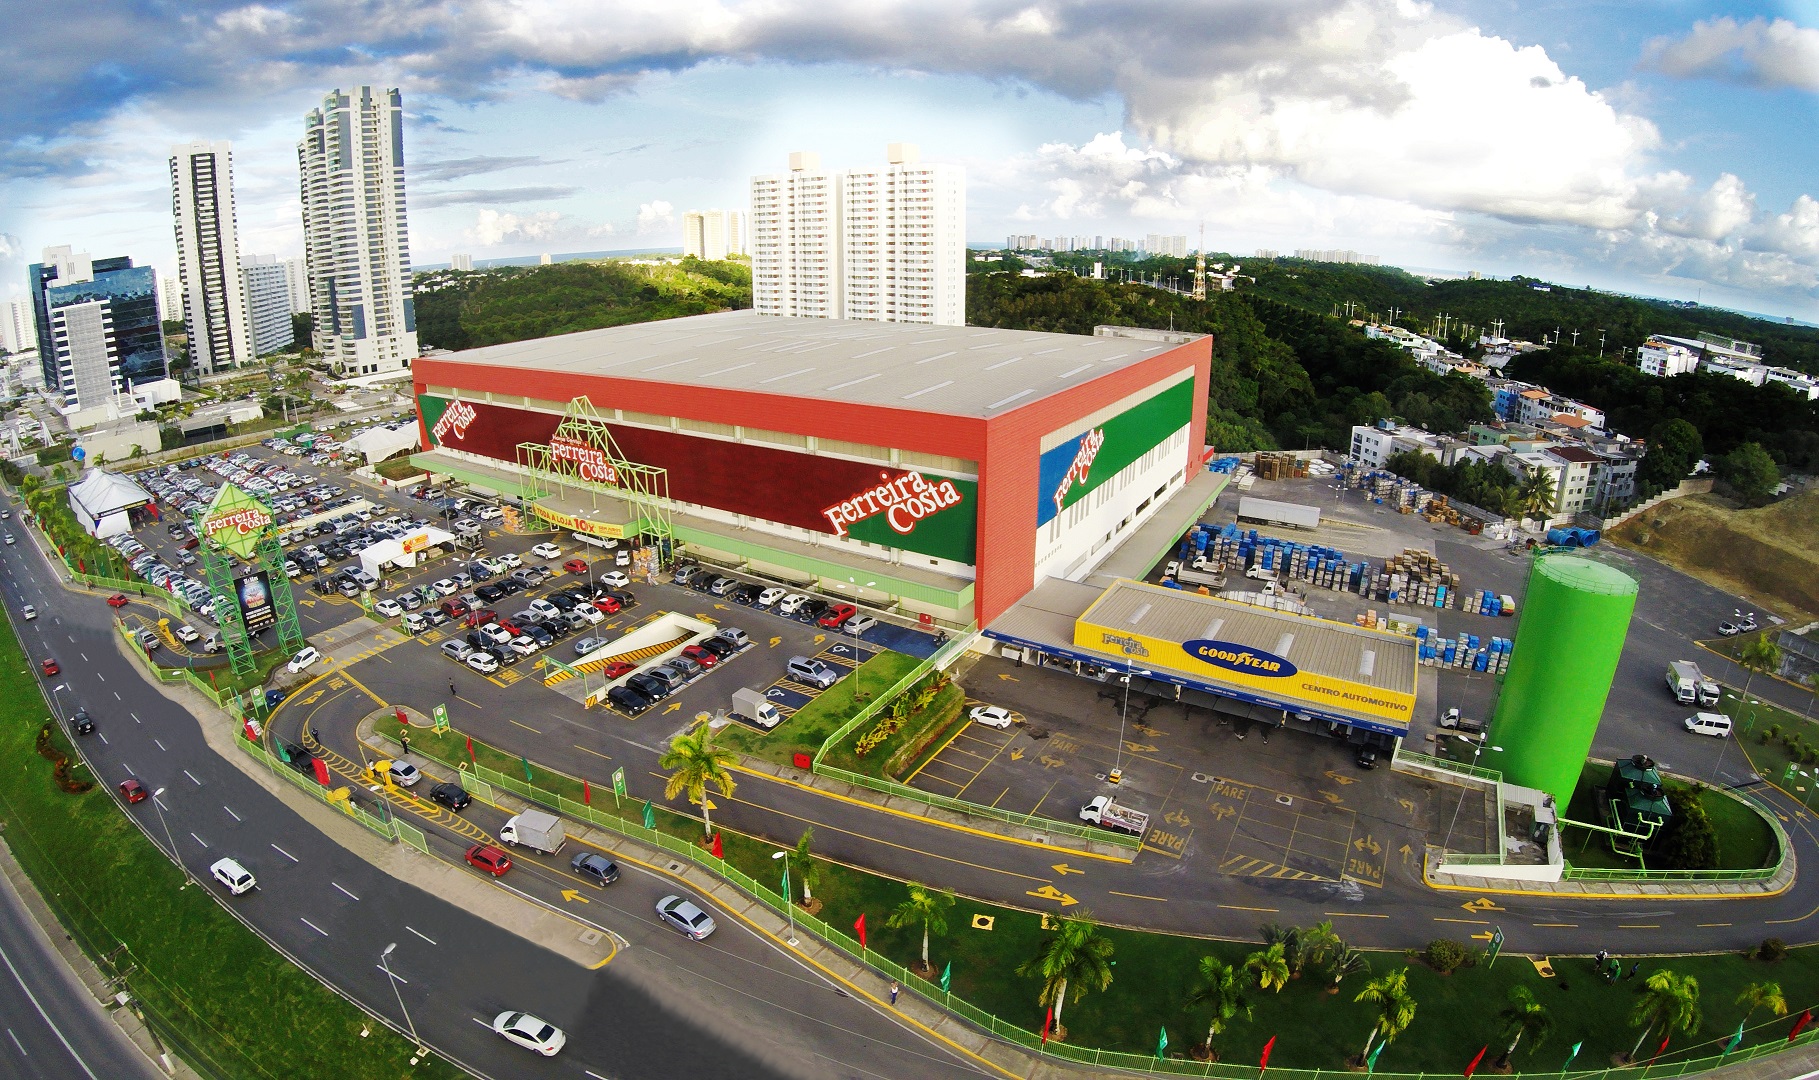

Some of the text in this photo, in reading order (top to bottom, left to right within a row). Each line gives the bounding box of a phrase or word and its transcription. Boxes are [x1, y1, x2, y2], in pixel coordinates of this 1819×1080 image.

[432, 400, 464, 446] Ferreira
[453, 404, 477, 440] Costa
[550, 441, 604, 465] Ferreira
[1079, 428, 1105, 484] Costa
[580, 462, 617, 482] Costa
[1054, 428, 1096, 516] Ferreira
[823, 471, 928, 537] Ferreira
[887, 481, 961, 533] Costa
[205, 508, 260, 536] Ferreira
[237, 514, 272, 535] Costa
[1198, 645, 1281, 673] GOODYEAR
[1301, 683, 1408, 712] CENTRO AUTOMOTIVO
[1051, 738, 1081, 754] PARE
[1215, 784, 1246, 800] PARE
[1150, 829, 1185, 850] PARE
[1350, 858, 1381, 879] PARE
